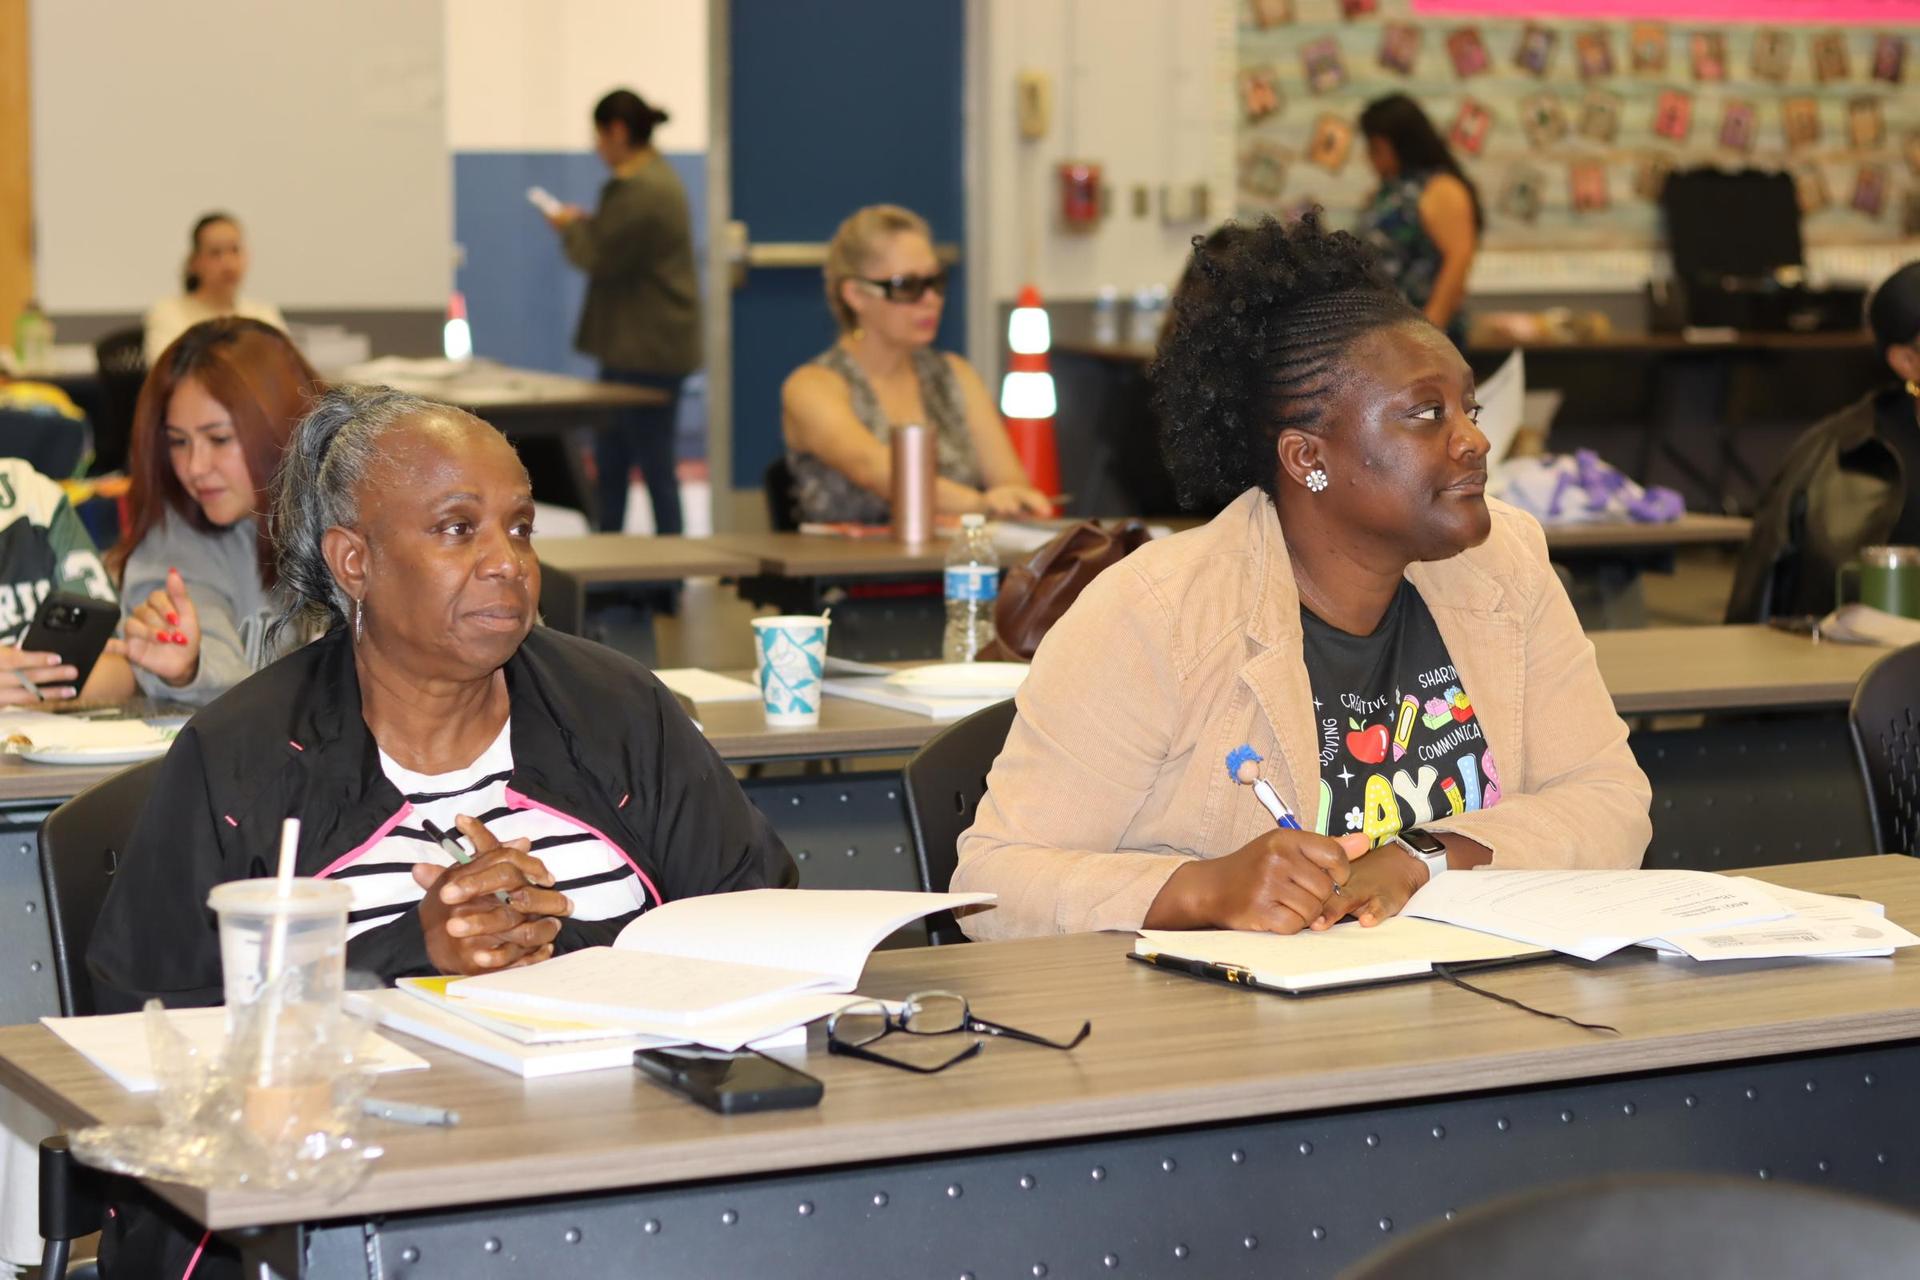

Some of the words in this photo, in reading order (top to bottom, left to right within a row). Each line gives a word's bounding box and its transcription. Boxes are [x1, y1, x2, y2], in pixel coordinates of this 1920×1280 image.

[1340, 693, 1388, 715] CREATIVE
[1319, 718, 1340, 767] SOLVING
[1418, 721, 1482, 761] COMMUNICA
